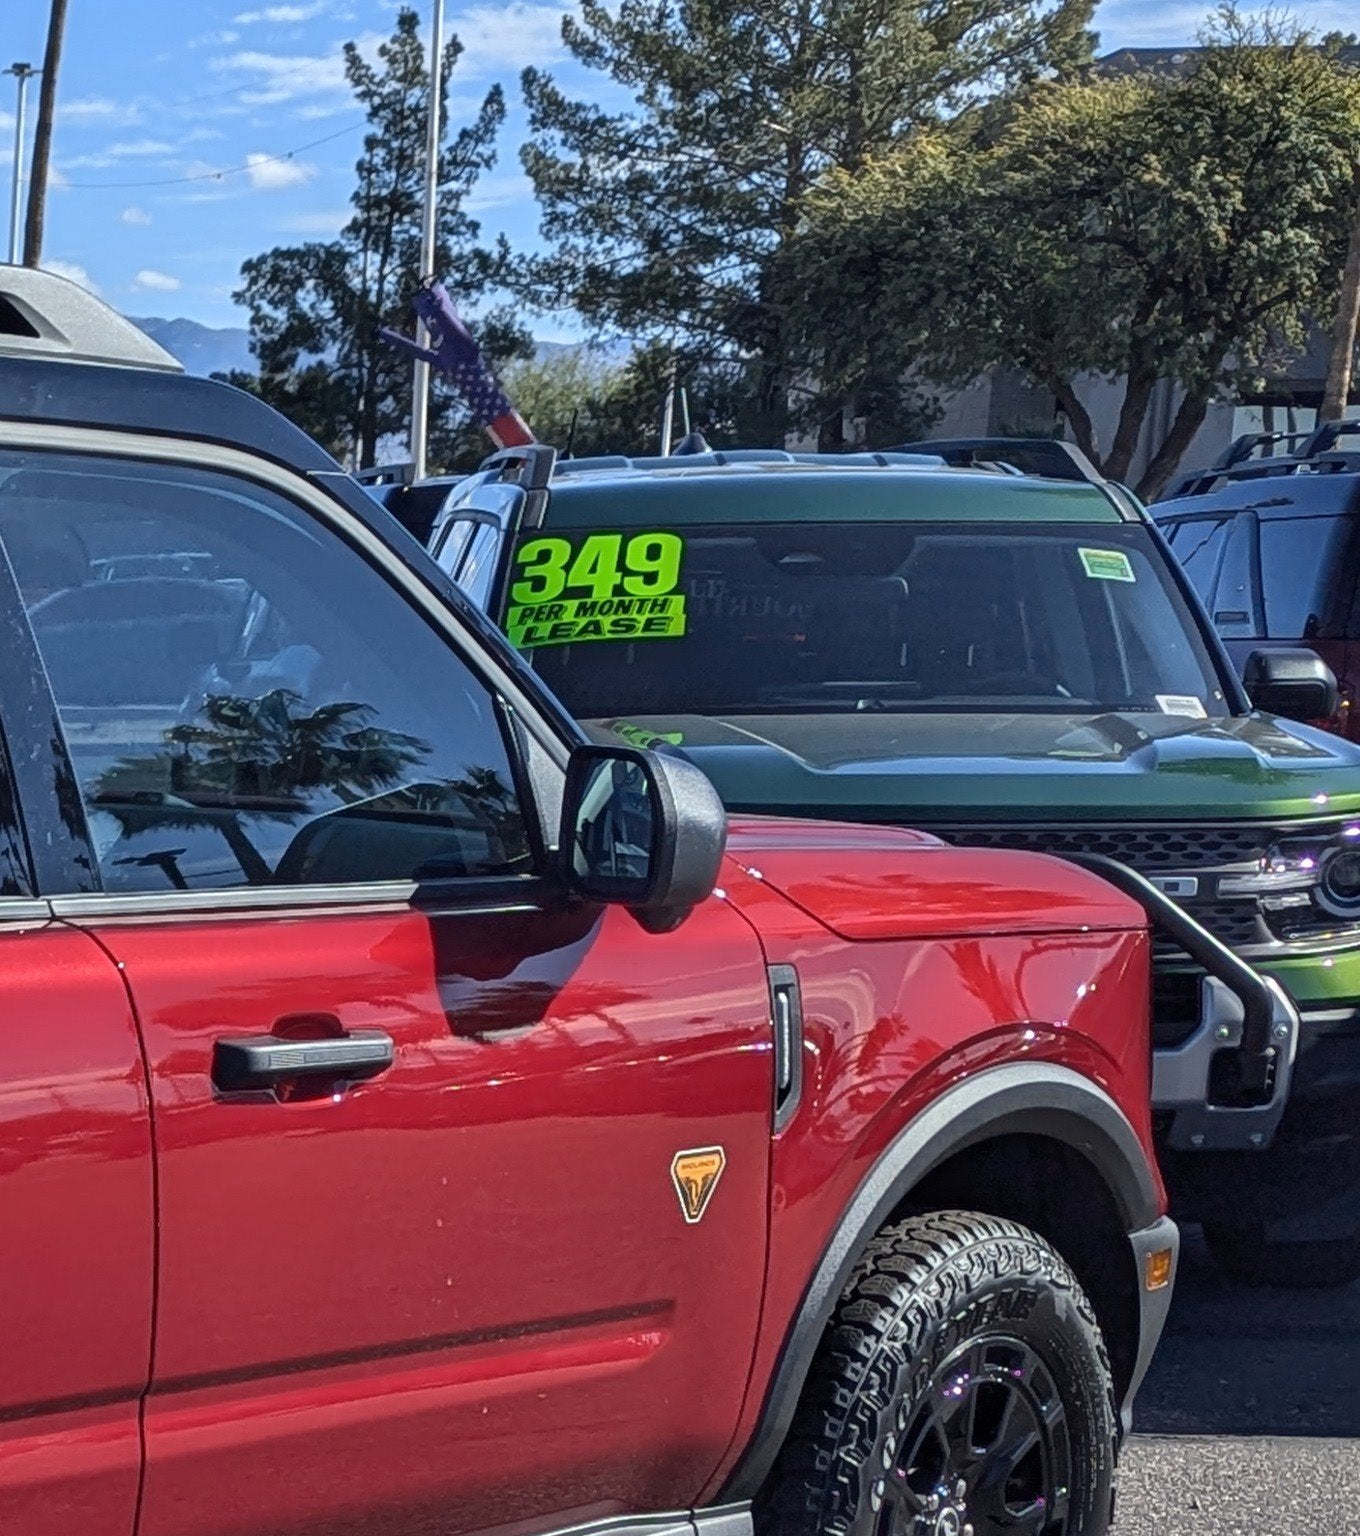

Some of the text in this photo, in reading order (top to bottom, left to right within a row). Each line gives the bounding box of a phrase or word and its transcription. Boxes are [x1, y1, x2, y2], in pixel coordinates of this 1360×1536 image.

[512, 533, 682, 604] 349
[518, 603, 568, 626] PER
[574, 597, 673, 618] MONTH
[521, 616, 673, 644] LEASE
